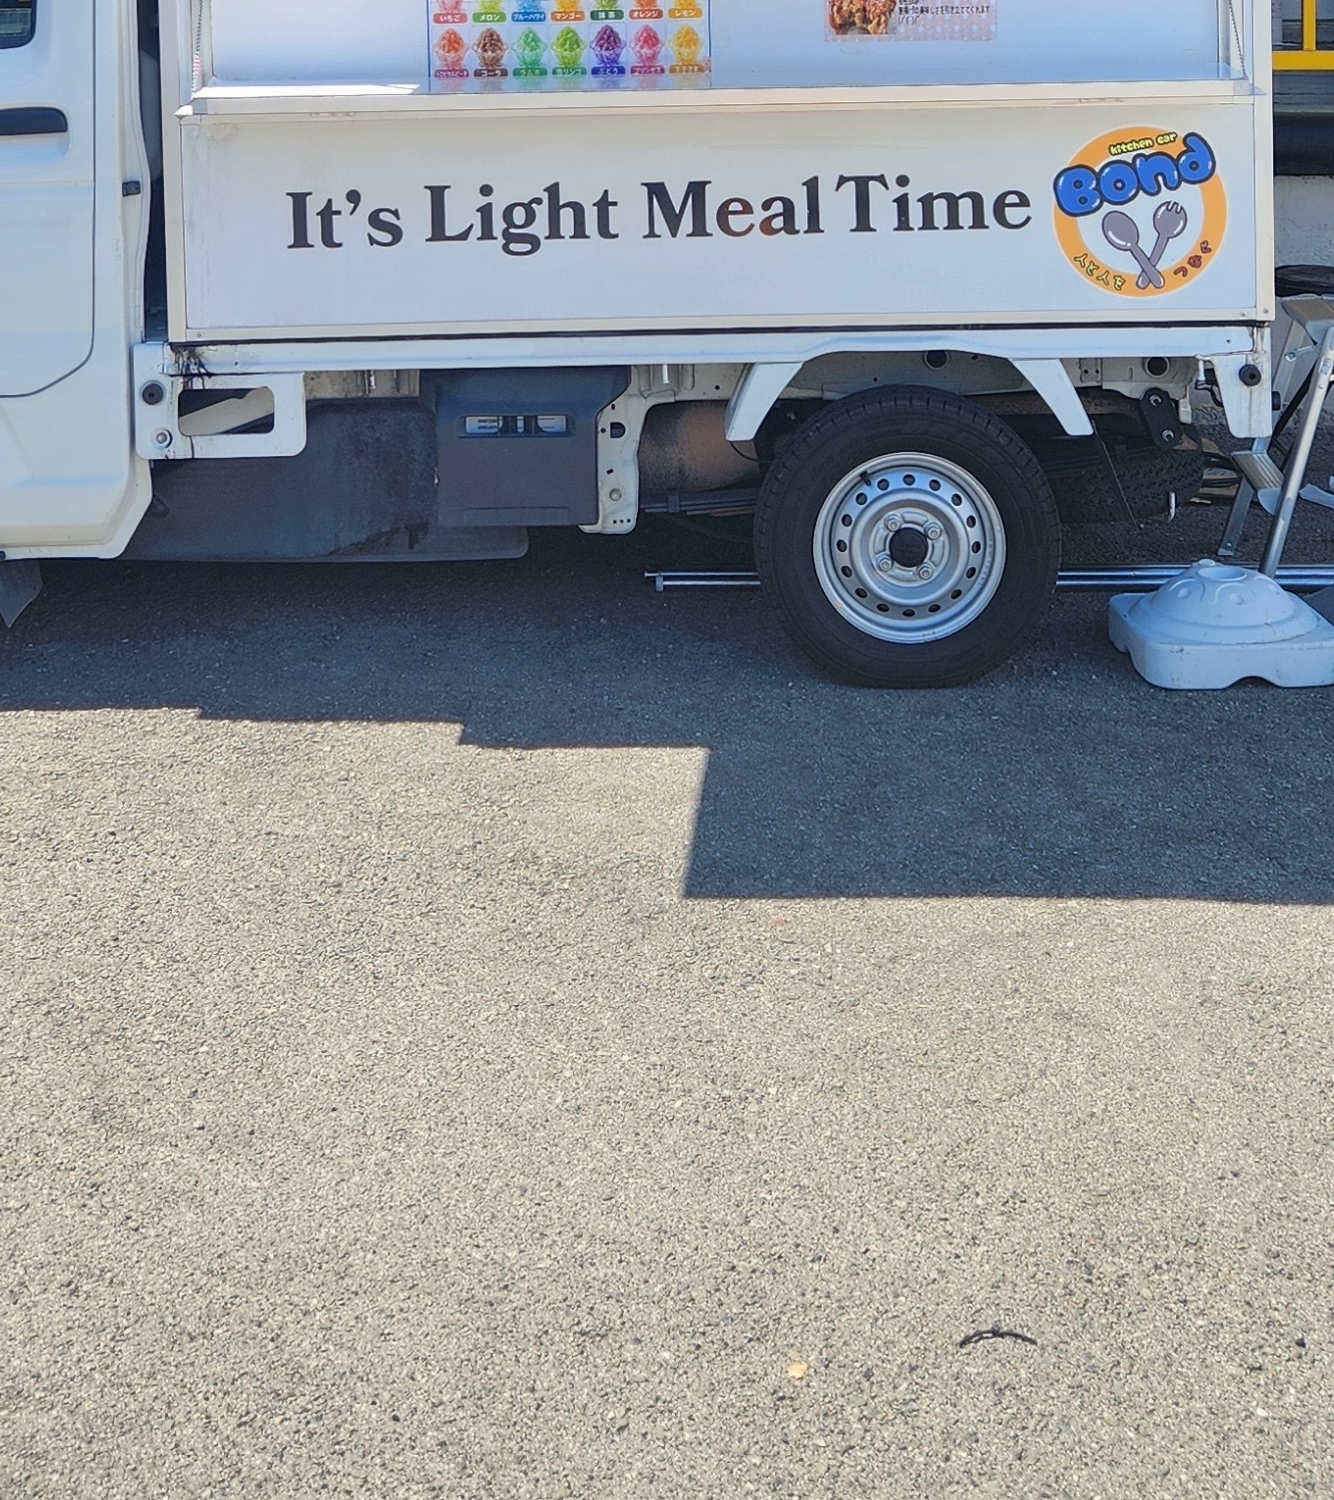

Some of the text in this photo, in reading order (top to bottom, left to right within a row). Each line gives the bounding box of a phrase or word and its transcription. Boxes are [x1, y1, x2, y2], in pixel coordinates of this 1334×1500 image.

[439, 14, 461, 22] いちご
[513, 13, 545, 21] ブルーハワイ
[555, 12, 581, 20] マンゴー
[632, 10, 658, 18] オレンジ
[1109, 132, 1177, 156] kitchen car
[1054, 132, 1216, 217] Bond
[286, 174, 1031, 256] It's Light Meal Time
